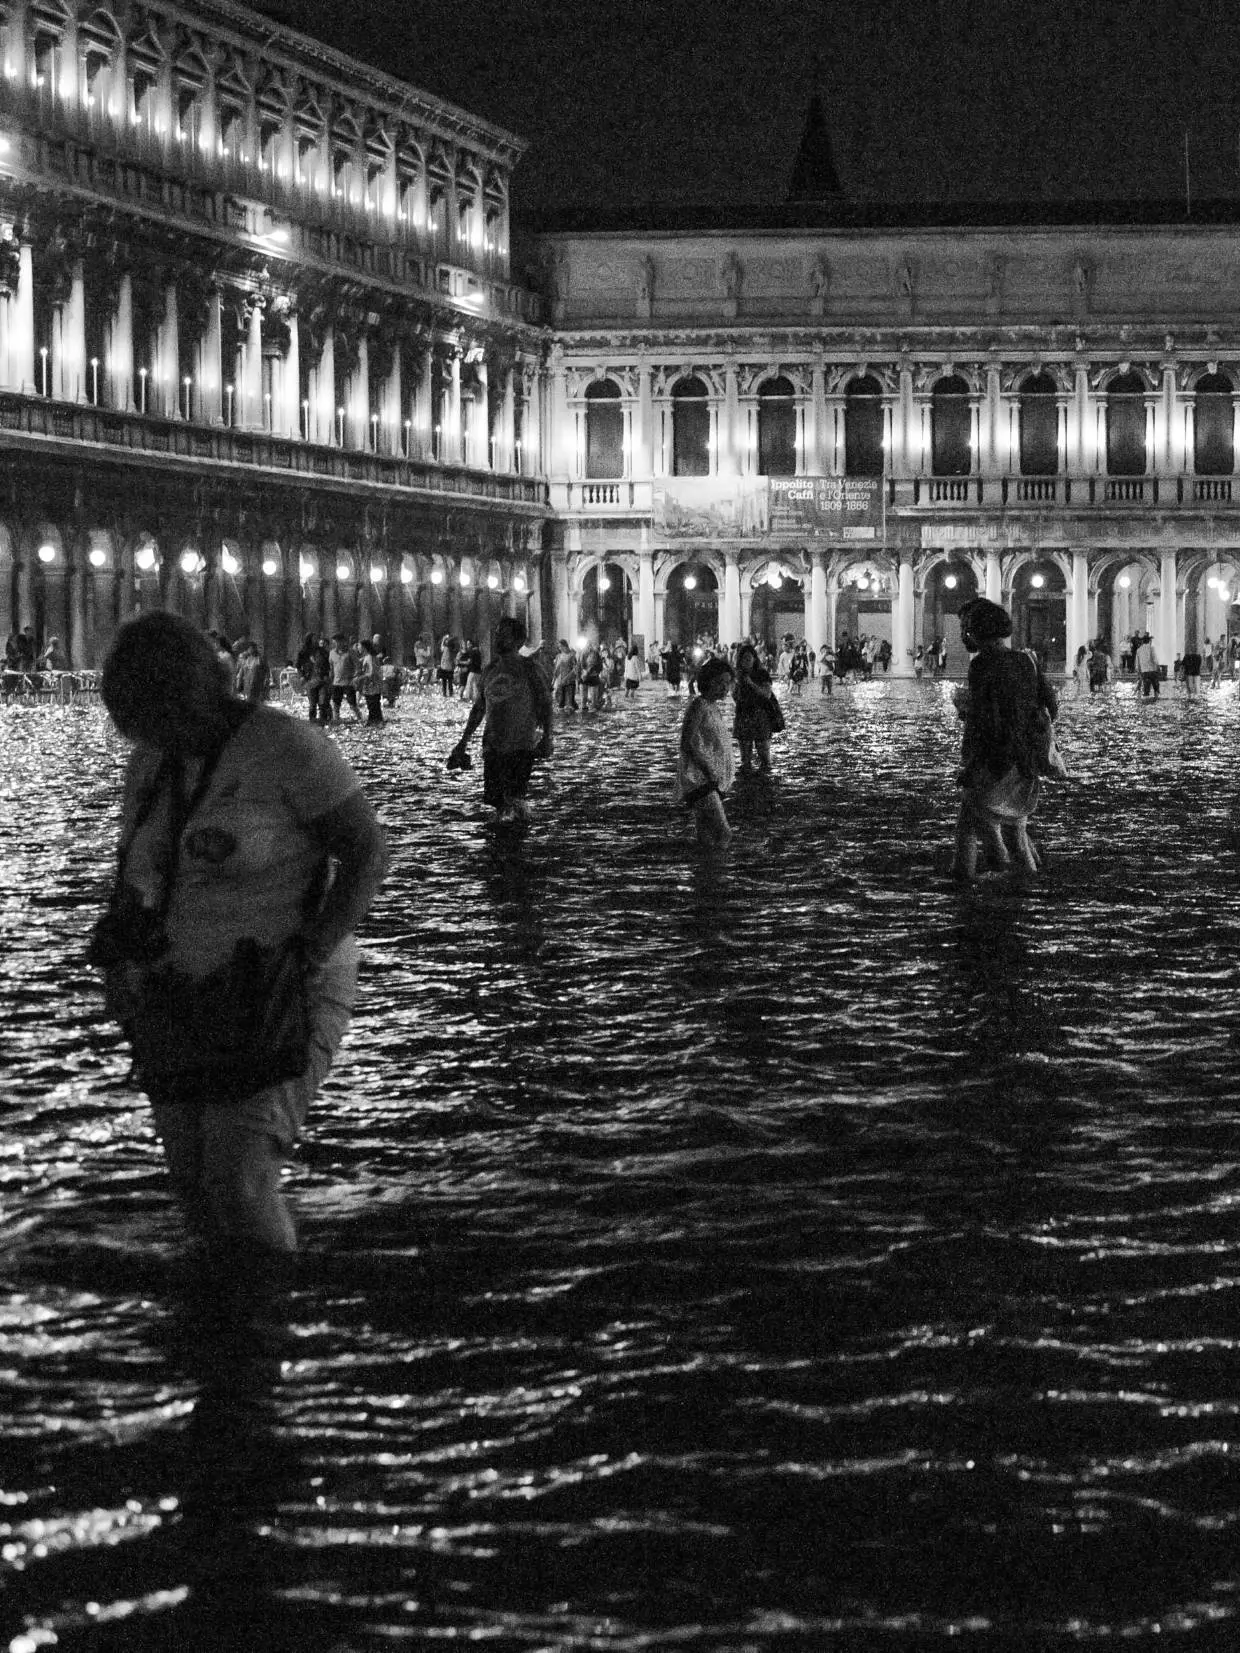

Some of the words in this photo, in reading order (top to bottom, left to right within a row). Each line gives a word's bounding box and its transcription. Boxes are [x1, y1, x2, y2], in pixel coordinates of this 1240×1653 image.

[770, 479, 814, 490] Ippolito
[820, 479, 837, 489] Tra
[839, 479, 878, 490] Venezia
[787, 490, 814, 500] Caffi
